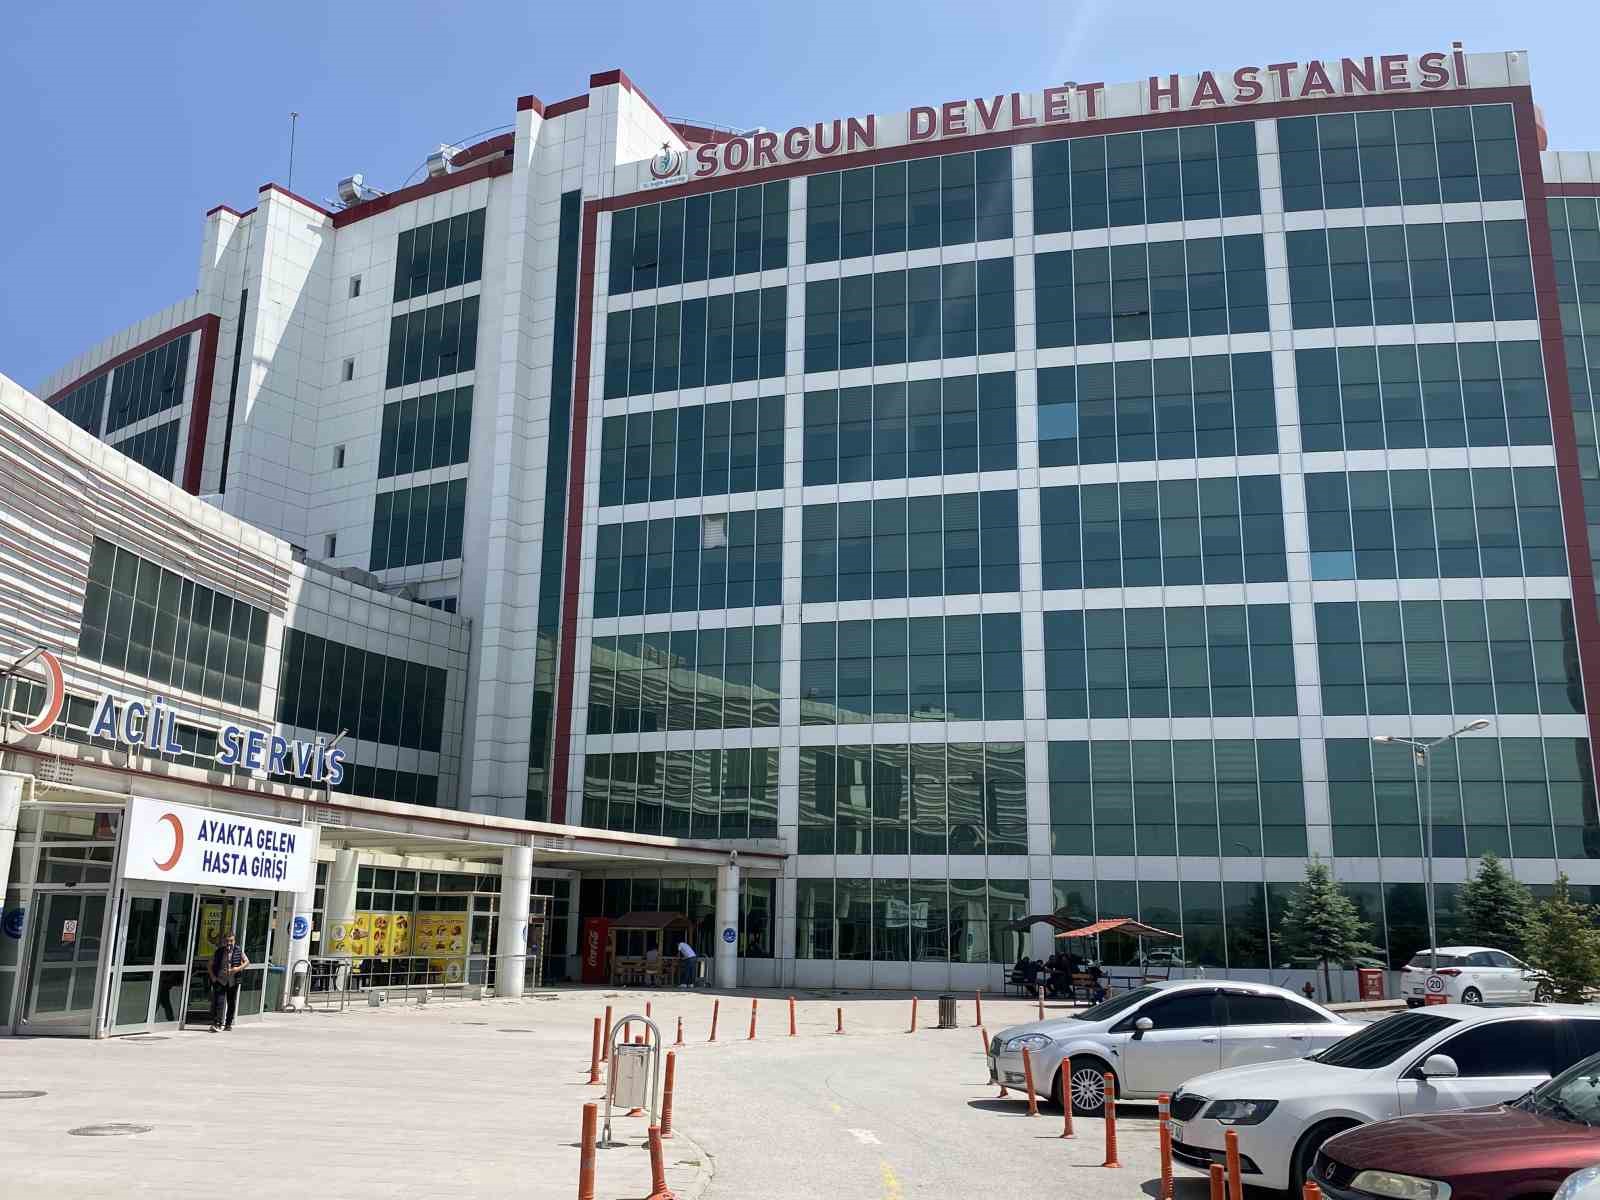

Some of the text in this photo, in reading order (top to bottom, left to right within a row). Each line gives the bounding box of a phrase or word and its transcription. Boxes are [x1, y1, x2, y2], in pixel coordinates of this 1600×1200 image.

[694, 41, 1466, 177] SORGUN DEVLET HASTANESİ
[92, 694, 345, 785] ACİL SERVİS
[197, 819, 296, 854] AYAKTA GELEN
[202, 850, 288, 882] HASTA GİRİŞİ
[1430, 980, 1441, 989] 20
